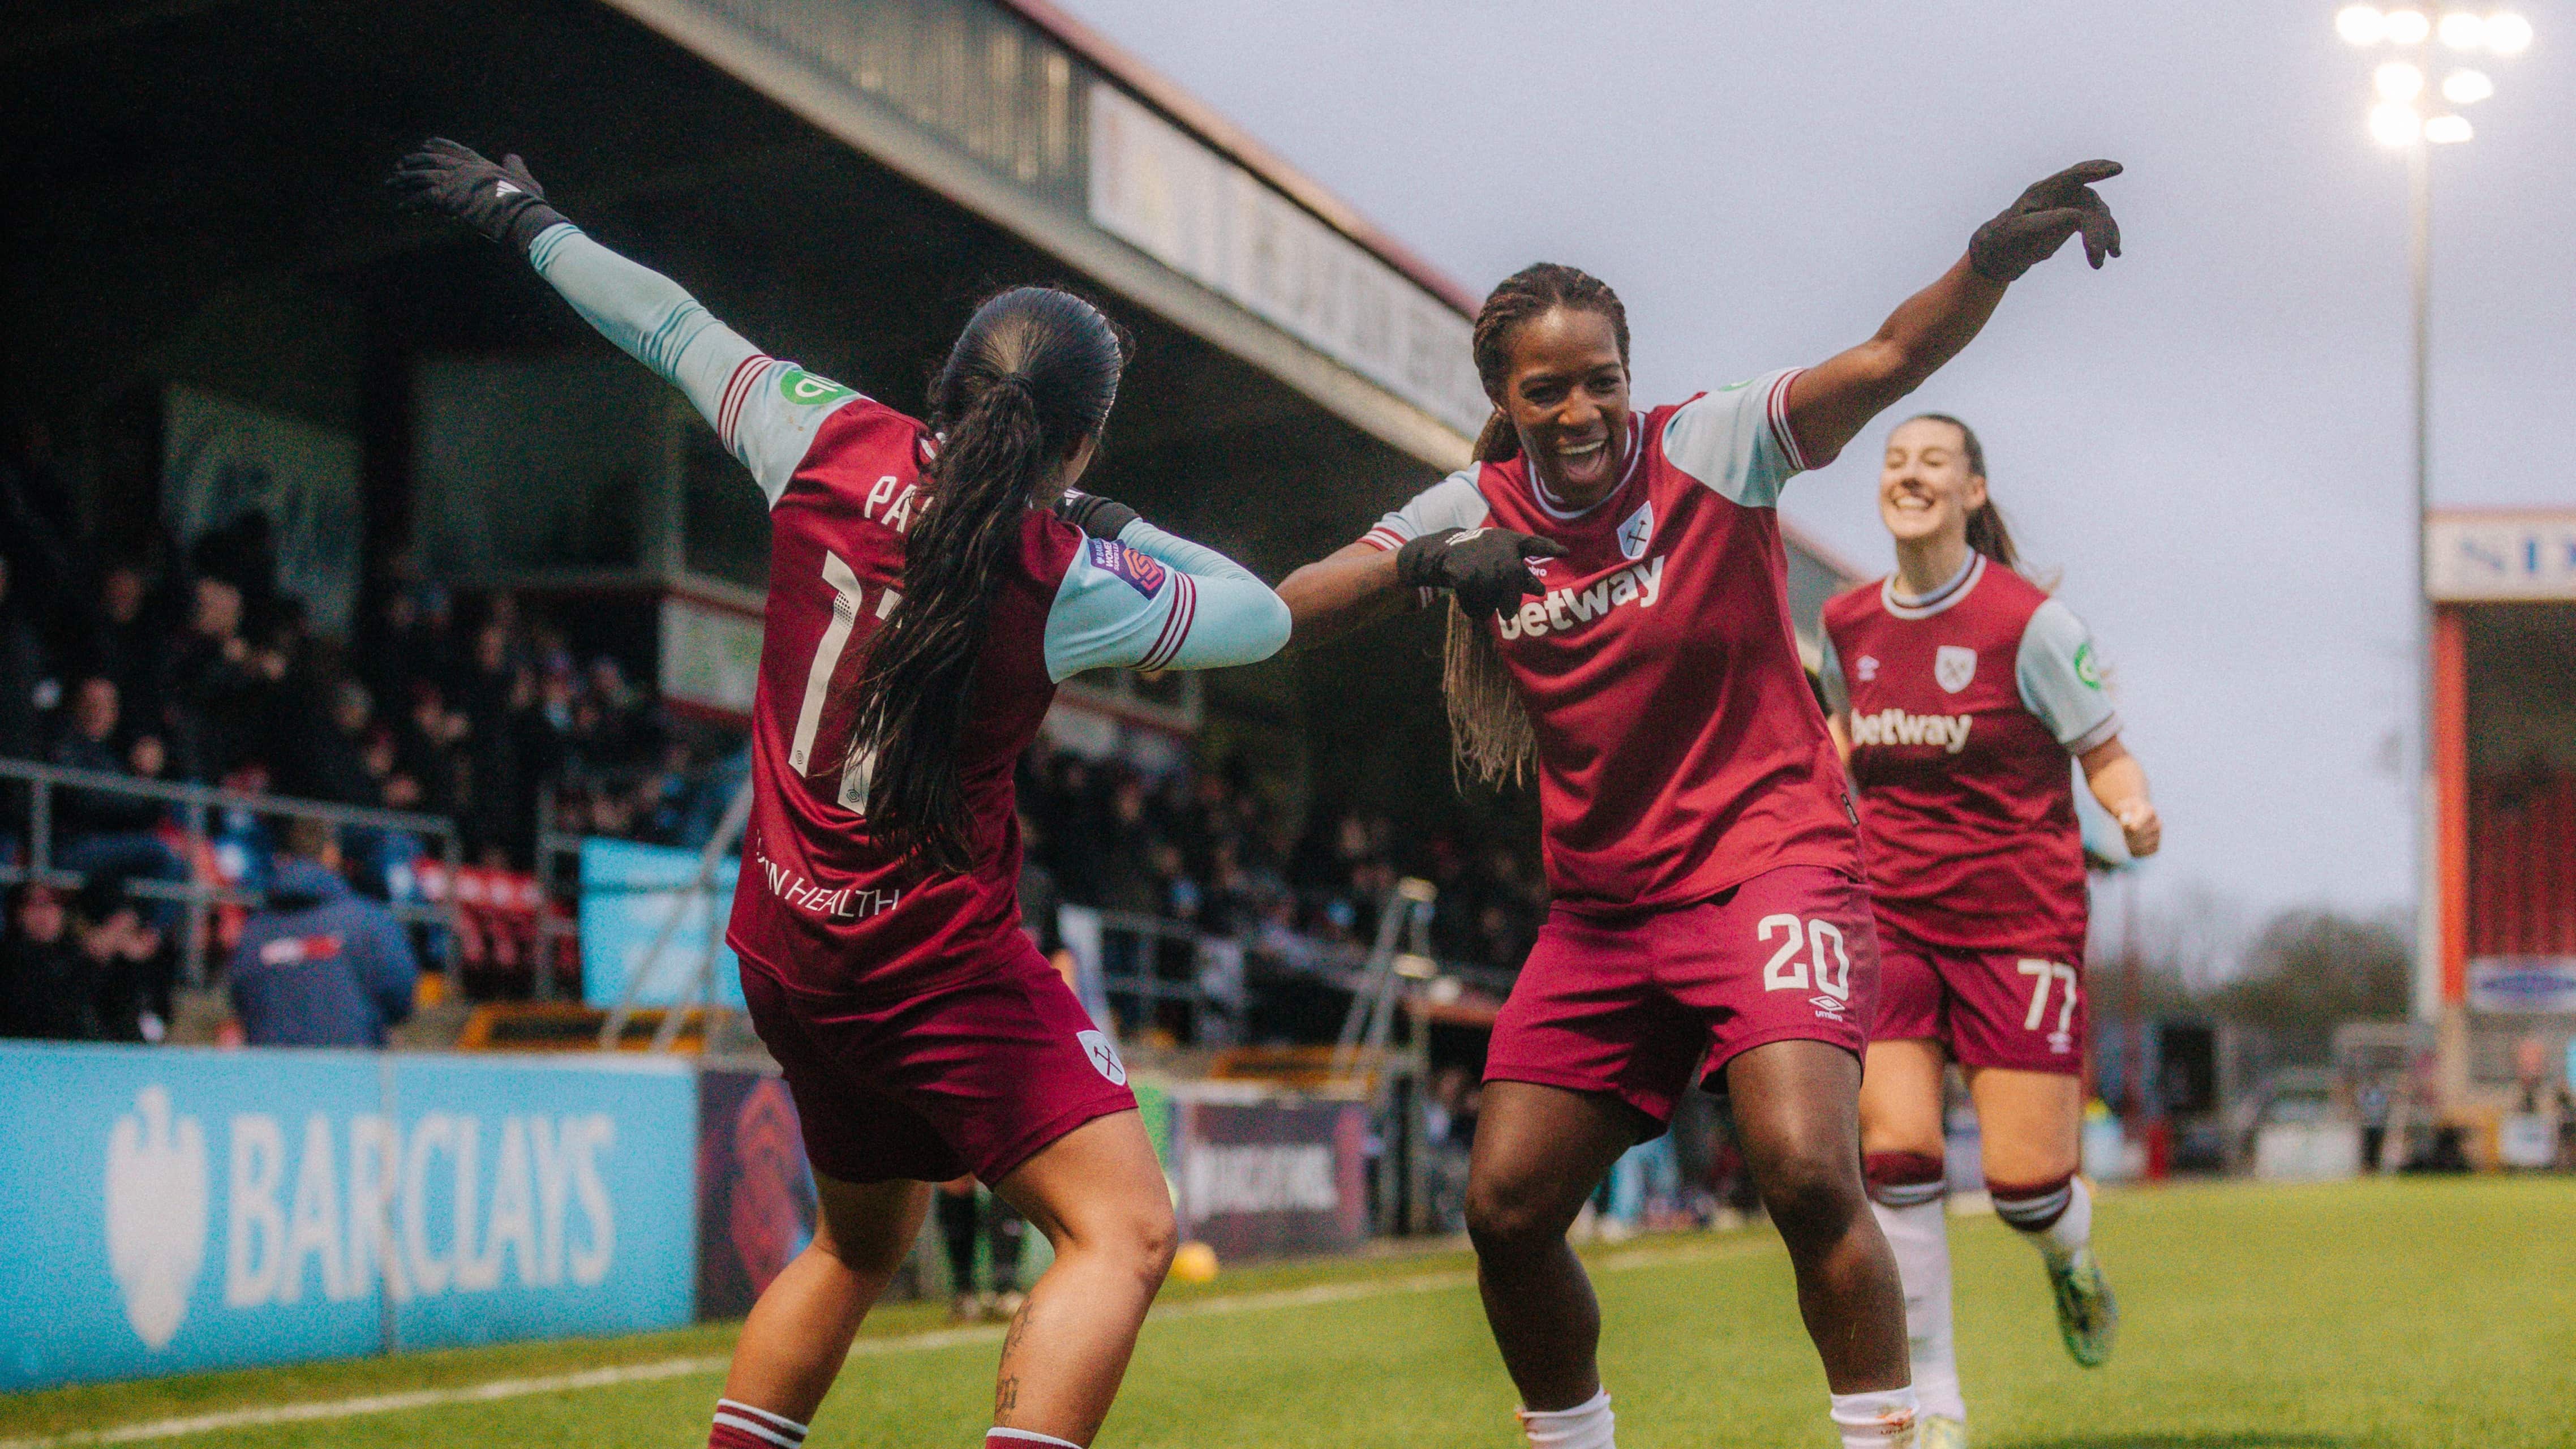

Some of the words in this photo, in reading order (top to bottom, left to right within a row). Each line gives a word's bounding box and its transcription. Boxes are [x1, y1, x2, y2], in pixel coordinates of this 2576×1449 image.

[1851, 708, 1973, 753] betway
[785, 877, 899, 918] HEALTH
[1758, 913, 1849, 1001] 20
[2017, 958, 2077, 1033] 77
[225, 1111, 618, 1307] BARCLAYS
